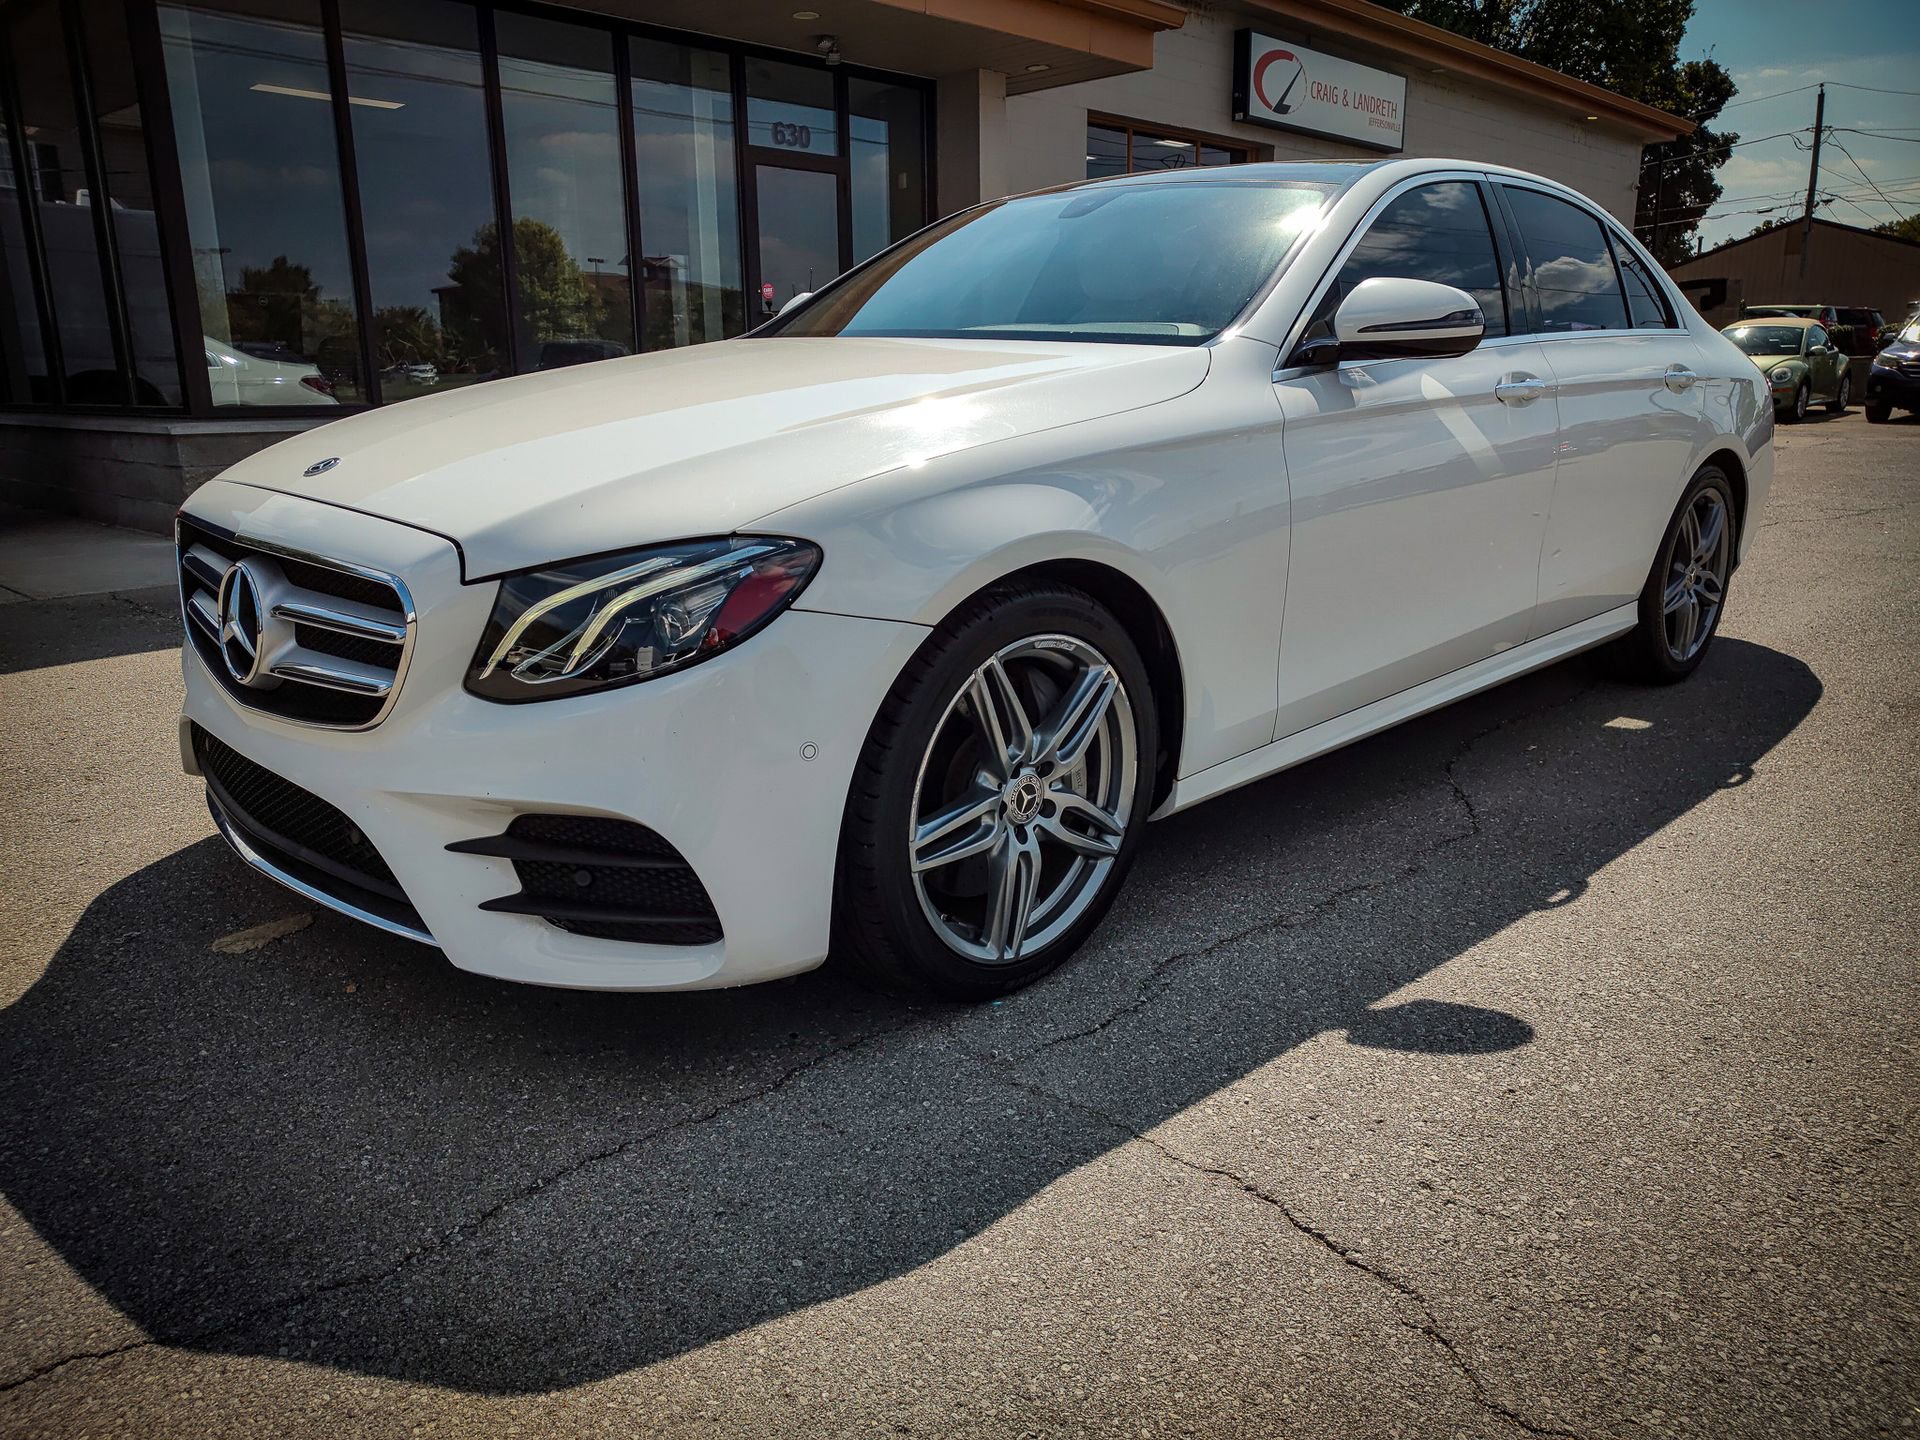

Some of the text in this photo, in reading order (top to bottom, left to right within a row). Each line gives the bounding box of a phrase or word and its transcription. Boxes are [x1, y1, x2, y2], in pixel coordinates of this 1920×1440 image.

[1310, 80, 1398, 119] CRAIG & LANDRETH
[771, 121, 811, 148] 630
